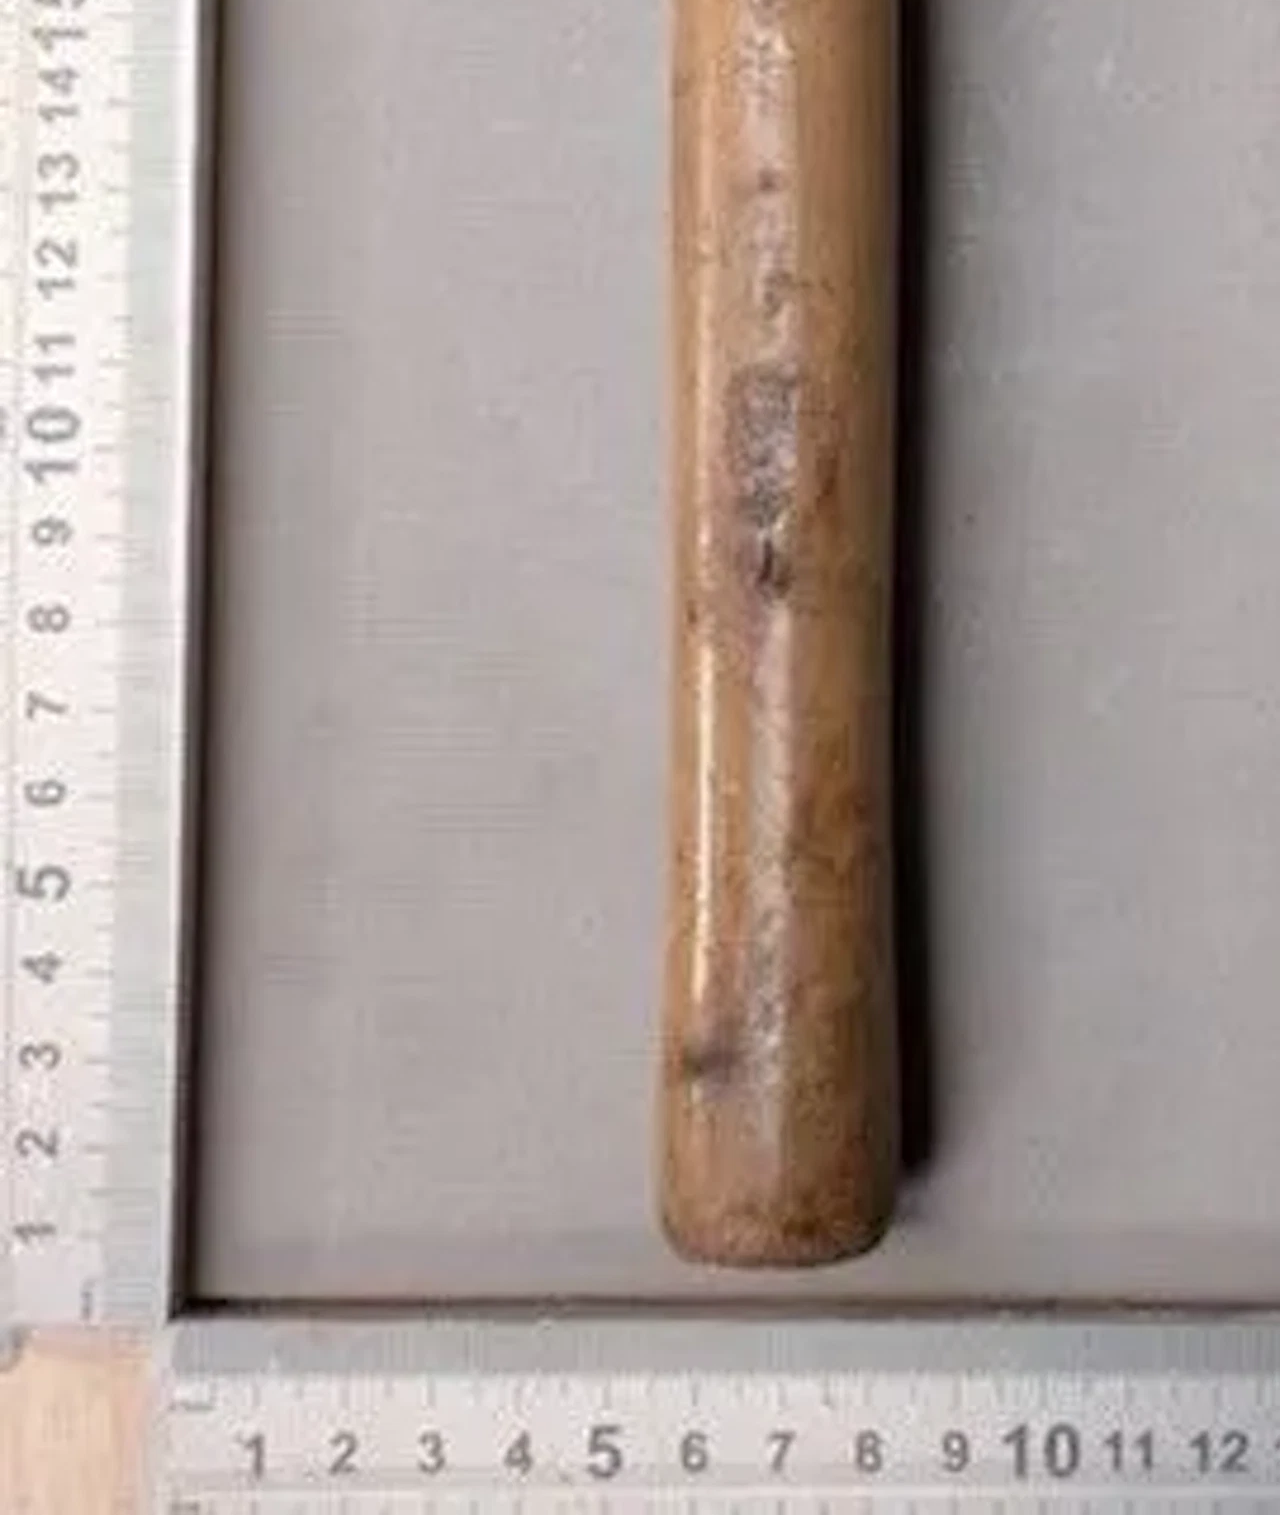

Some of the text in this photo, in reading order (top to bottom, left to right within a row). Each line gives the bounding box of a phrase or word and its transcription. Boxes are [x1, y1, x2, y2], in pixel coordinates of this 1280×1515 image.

[38, 67, 80, 125] 14
[37, 151, 80, 213] 13
[34, 238, 79, 300] 12
[32, 330, 76, 382] 11
[24, 406, 82, 484] 10
[30, 517, 74, 548] 9
[26, 603, 71, 635] 8
[25, 690, 69, 722] 7
[23, 778, 67, 808] 6
[17, 863, 71, 902] 5
[21, 950, 62, 983] 4
[20, 1041, 60, 1071] 3
[15, 1128, 59, 1158] 2
[13, 1220, 57, 1245] 1
[240, 1432, 269, 1477] 1
[328, 1432, 359, 1475] 2
[418, 1432, 446, 1475] 3
[503, 1432, 534, 1475] 4
[586, 1424, 624, 1480] 5
[678, 1432, 709, 1475] 6
[766, 1432, 797, 1475] 7
[854, 1432, 885, 1475] 8
[940, 1432, 971, 1474] 9
[1002, 1423, 1081, 1480] 10
[1103, 1431, 1157, 1473] 11
[1190, 1431, 1250, 1474] 12
